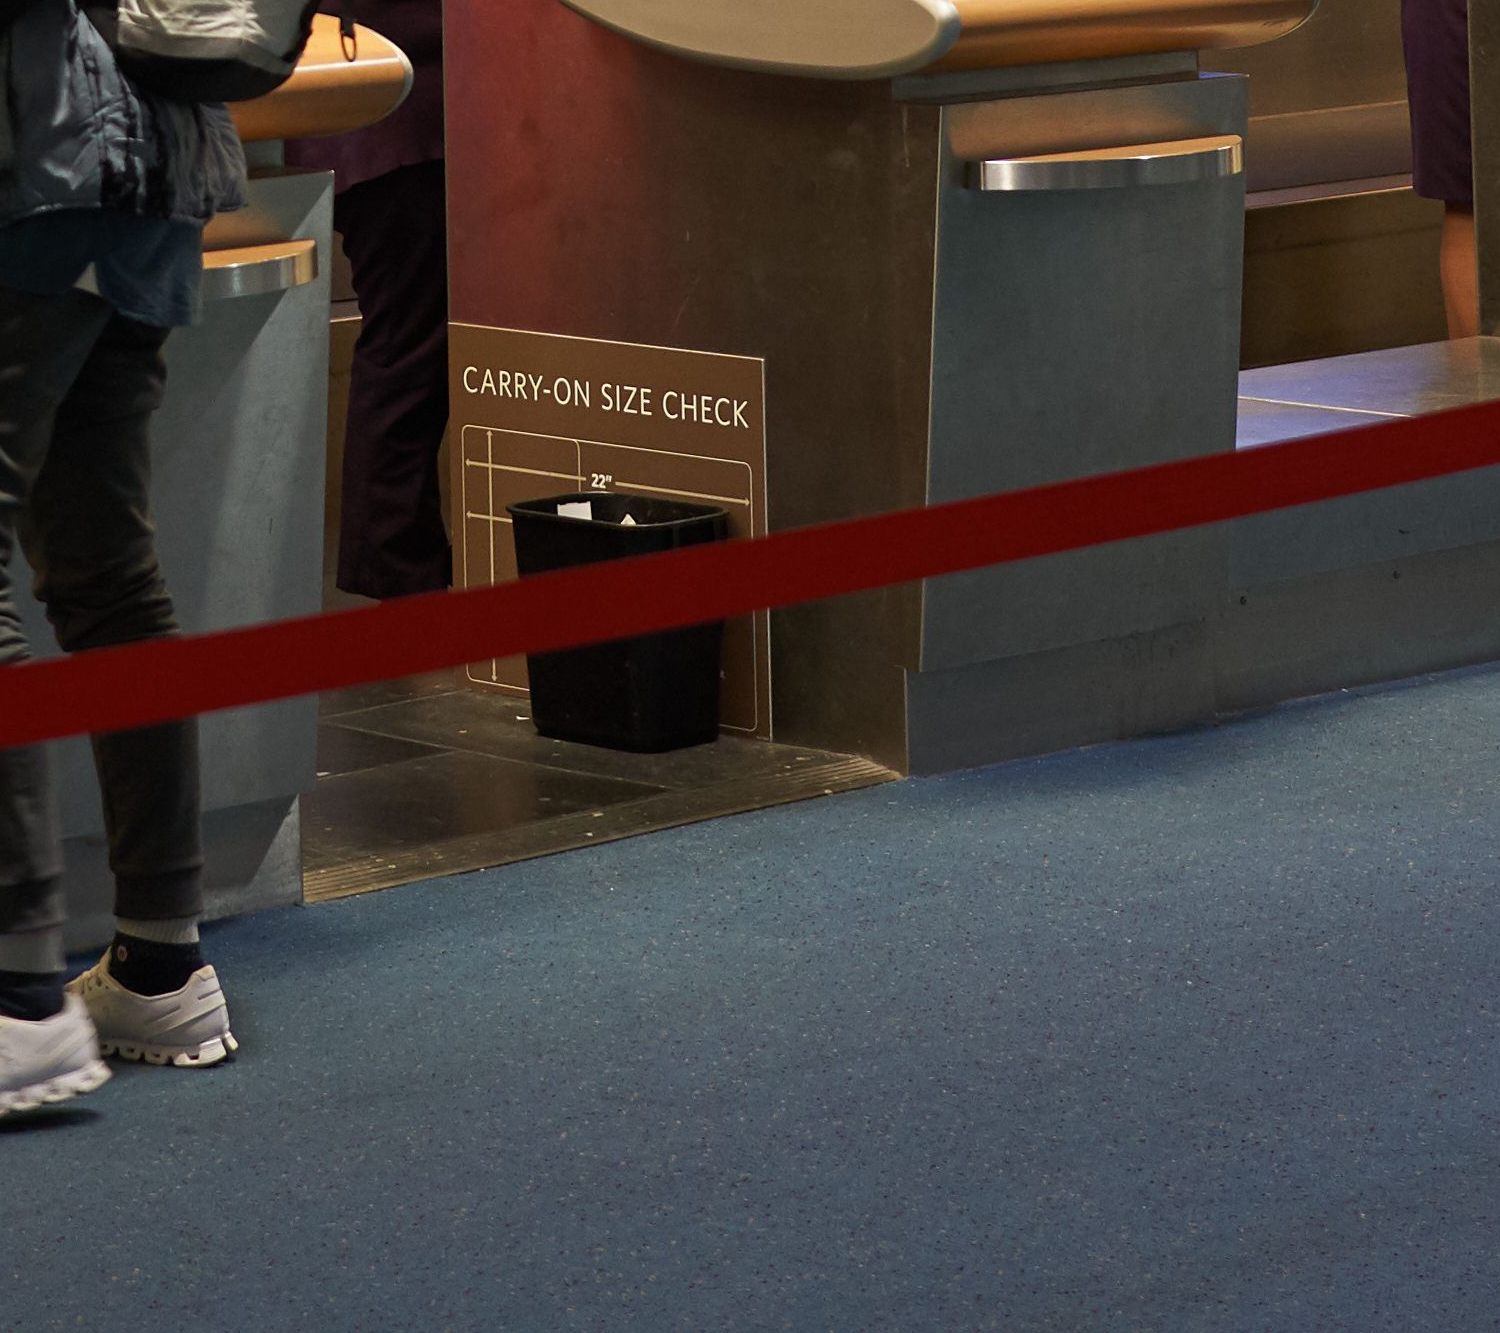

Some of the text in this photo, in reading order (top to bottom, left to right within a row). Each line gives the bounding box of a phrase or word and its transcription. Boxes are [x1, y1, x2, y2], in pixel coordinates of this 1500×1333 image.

[462, 366, 749, 429] CARRY-ON SIZE CHECK
[591, 473, 612, 489] 22"
